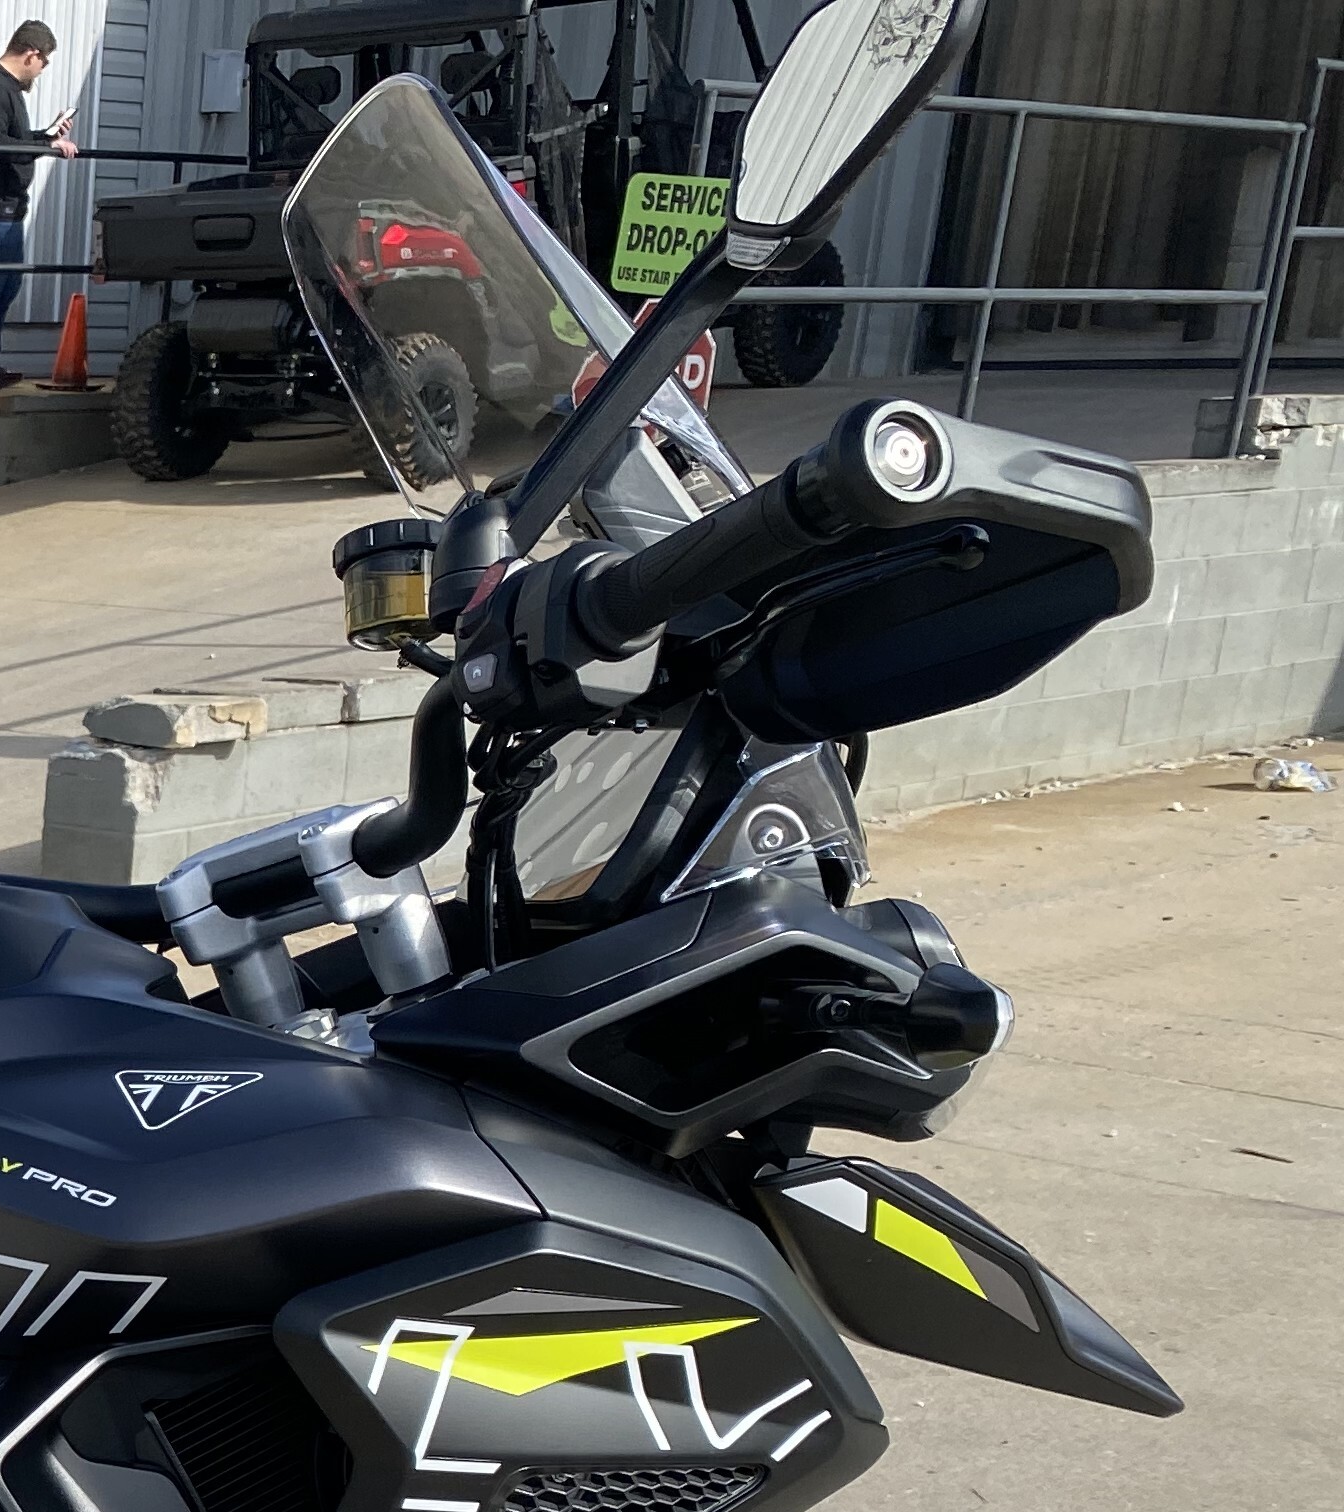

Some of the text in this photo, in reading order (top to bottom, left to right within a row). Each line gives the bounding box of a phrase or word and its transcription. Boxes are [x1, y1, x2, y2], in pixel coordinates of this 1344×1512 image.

[617, 266, 639, 282] USE
[640, 268, 671, 285] STAIR
[143, 1074, 230, 1083] TRIUMPH
[22, 1167, 118, 1208] PRO
